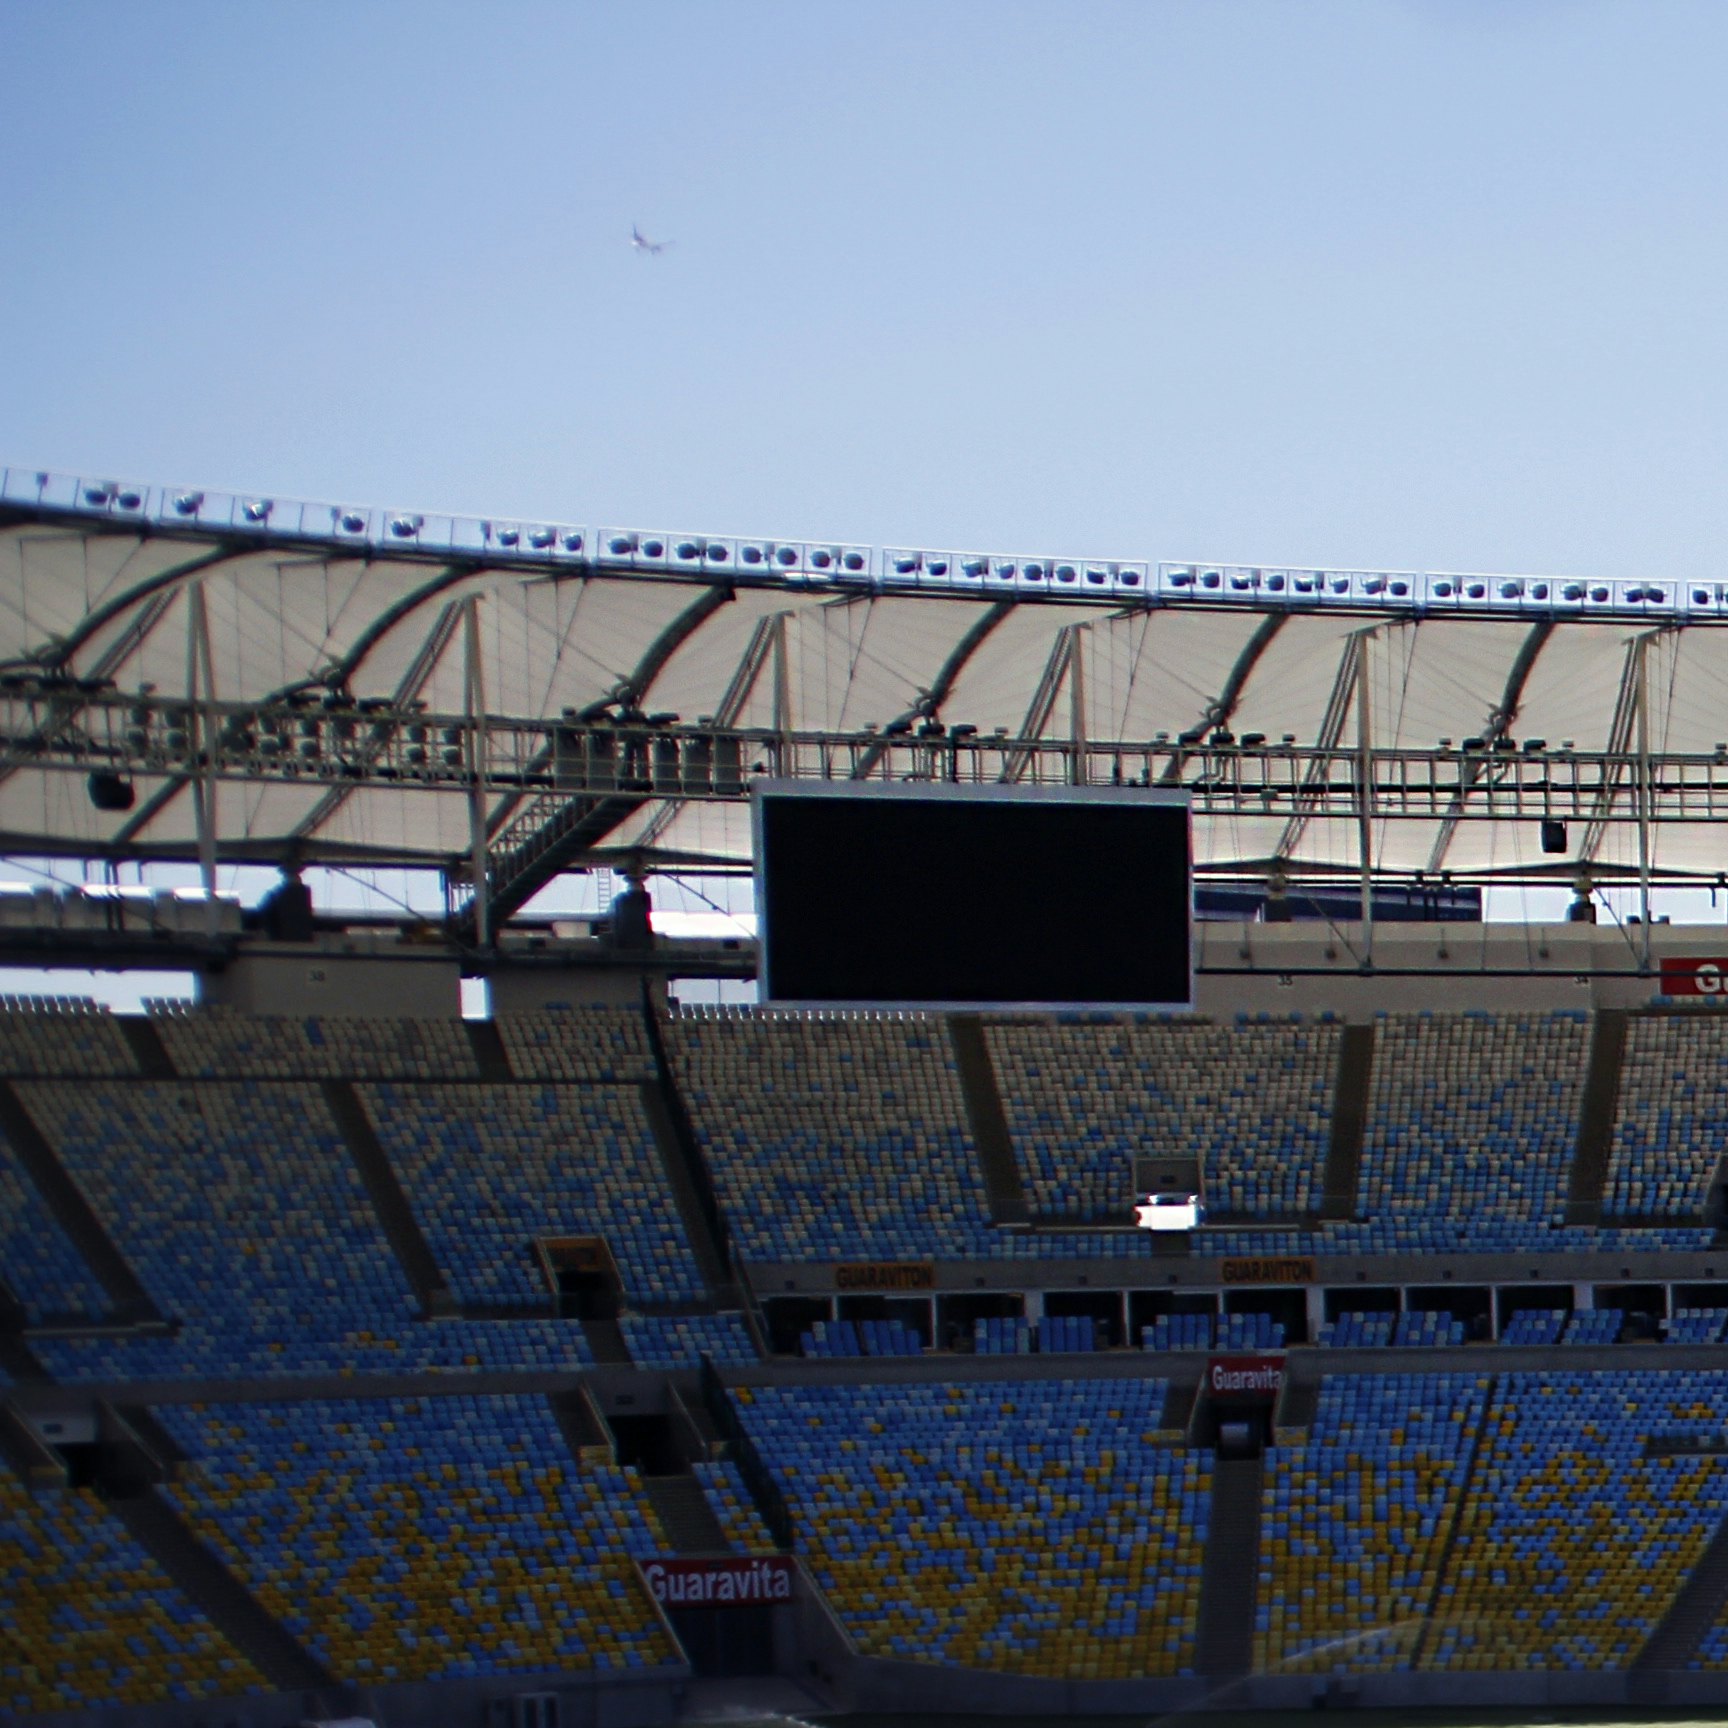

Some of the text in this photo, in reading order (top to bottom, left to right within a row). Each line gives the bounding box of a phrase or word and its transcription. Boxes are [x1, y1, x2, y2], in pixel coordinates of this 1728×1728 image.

[1222, 1260, 1312, 1282] GUARAVITON
[1213, 1365, 1282, 1389] Guaravita
[645, 1560, 790, 1602] Guaravita
